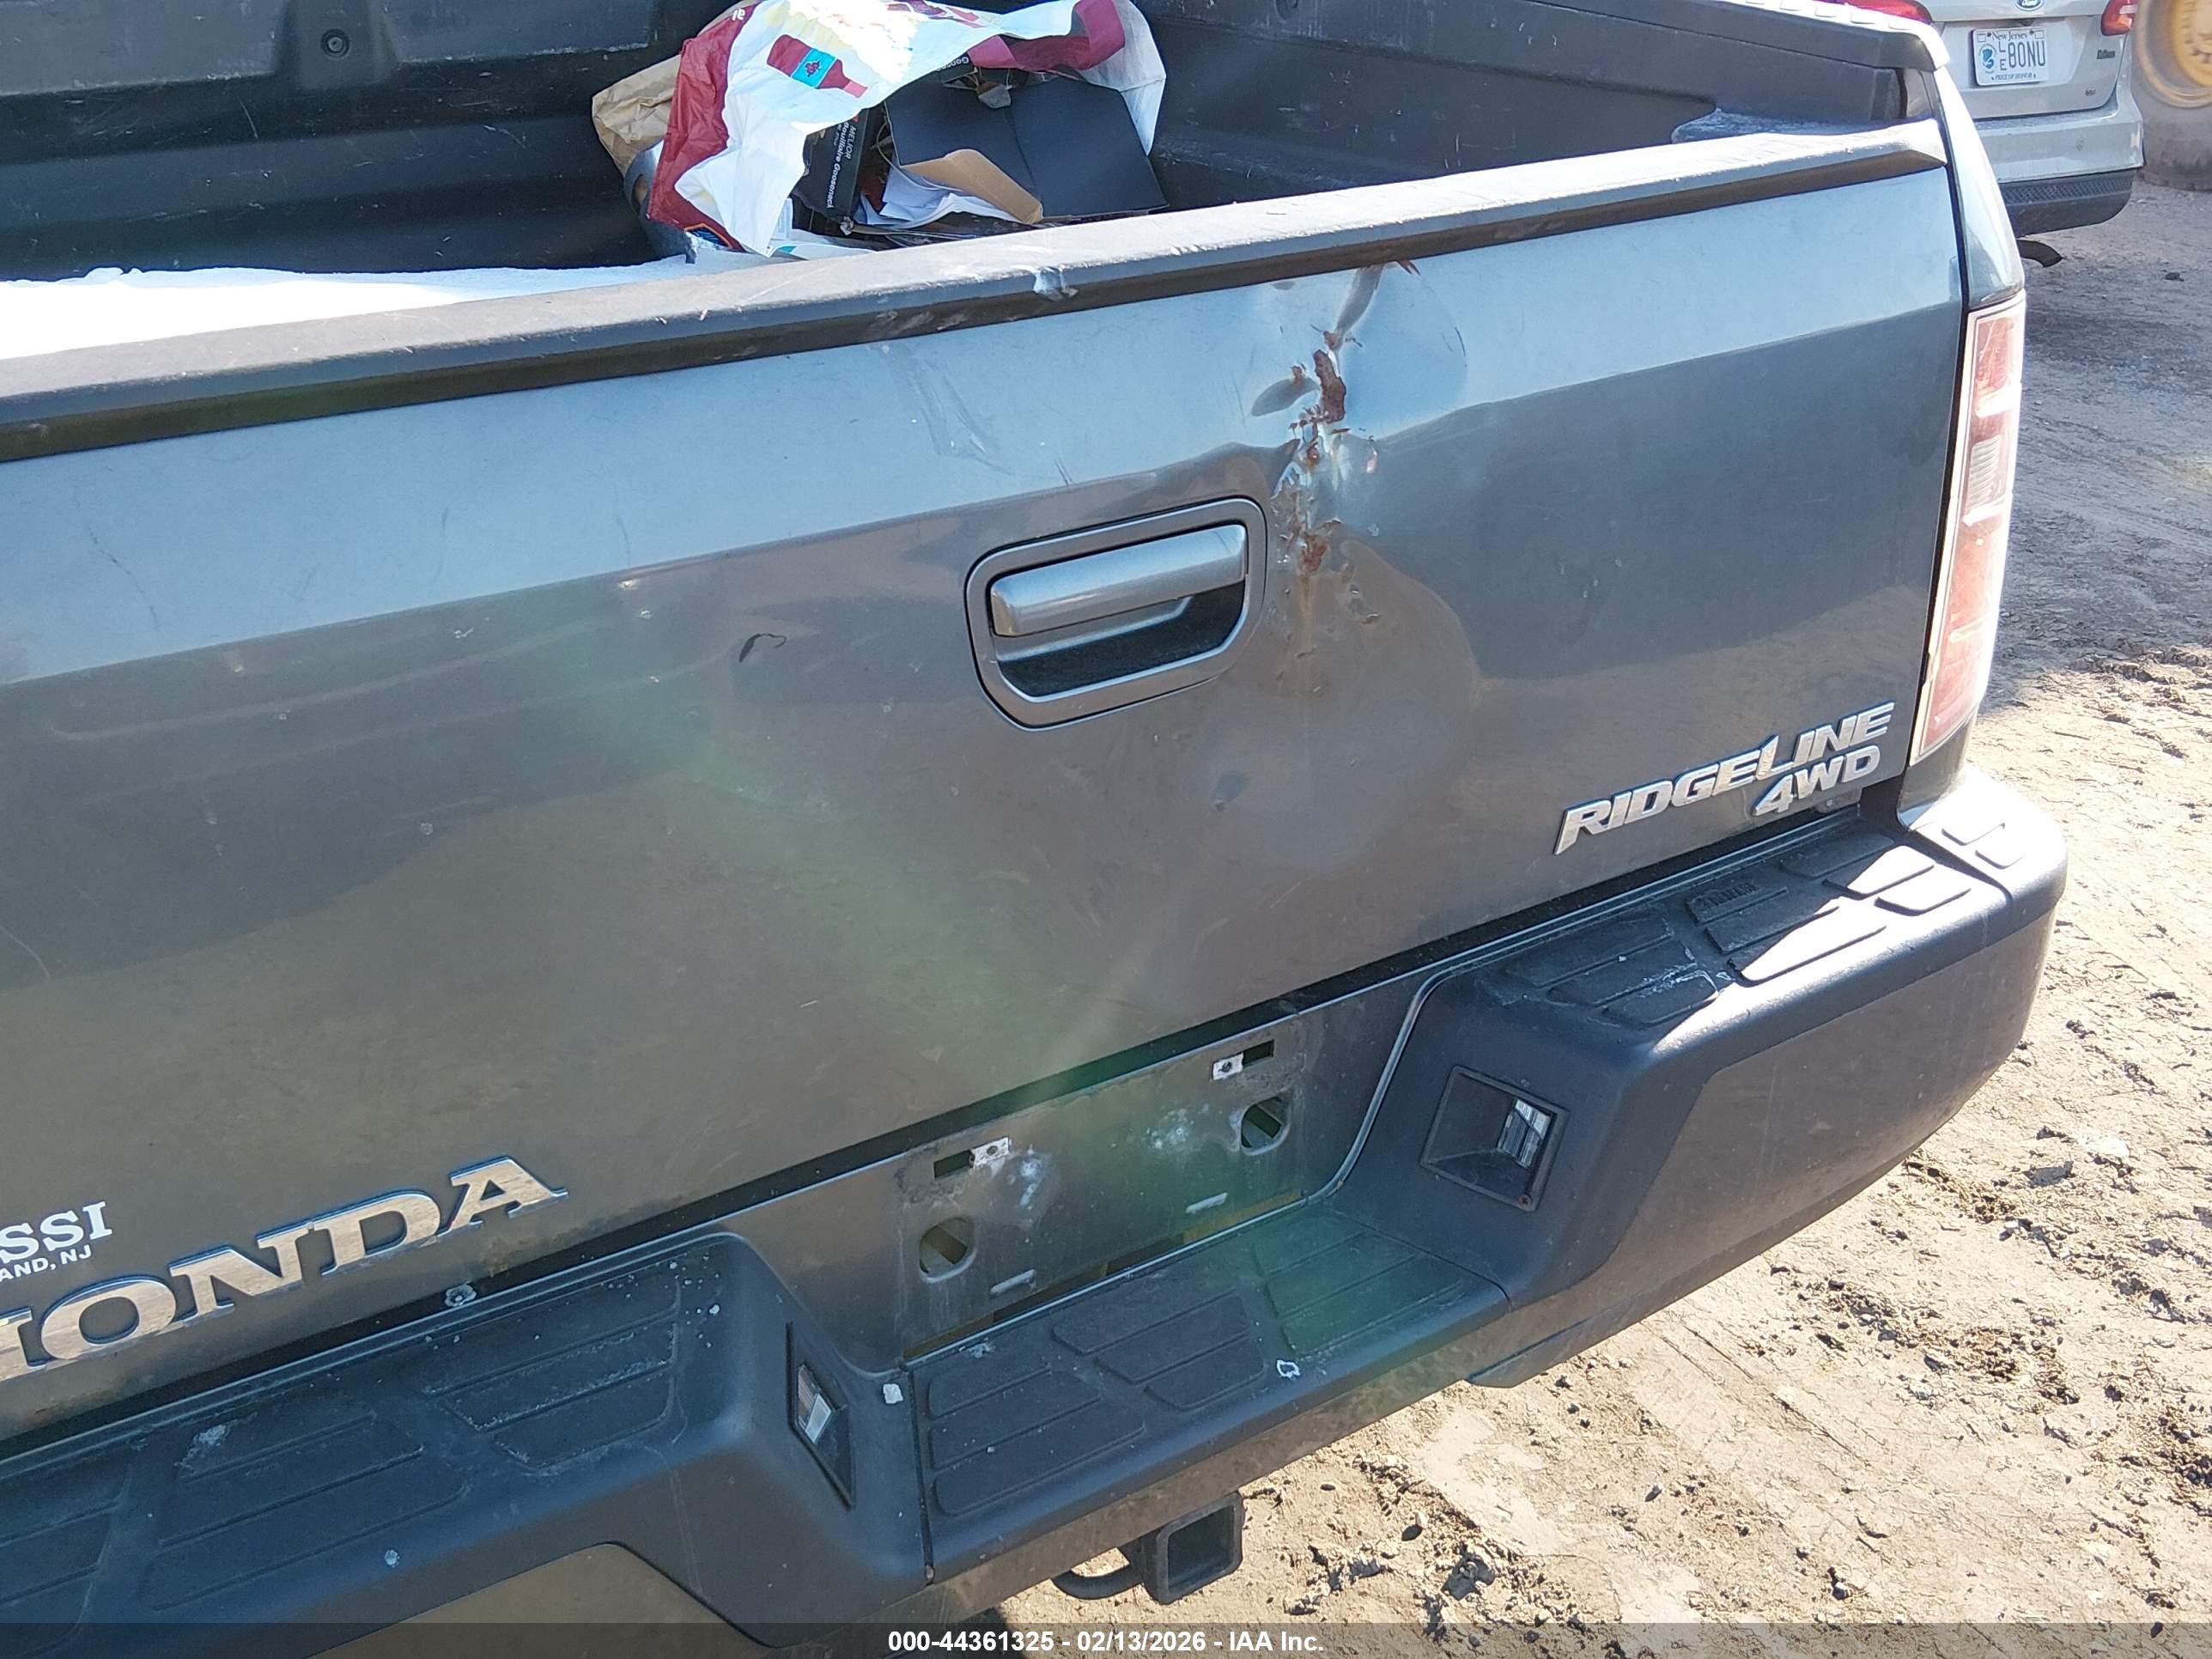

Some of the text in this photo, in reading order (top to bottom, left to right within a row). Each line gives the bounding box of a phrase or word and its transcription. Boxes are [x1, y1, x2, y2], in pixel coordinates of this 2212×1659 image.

[845, 125, 857, 160] MELIOR
[826, 163, 842, 209] Gooseneck
[1553, 701, 1895, 856] RIDGELINE
[1753, 744, 1881, 817] 4WD
[60, 1244, 93, 1265] NJ
